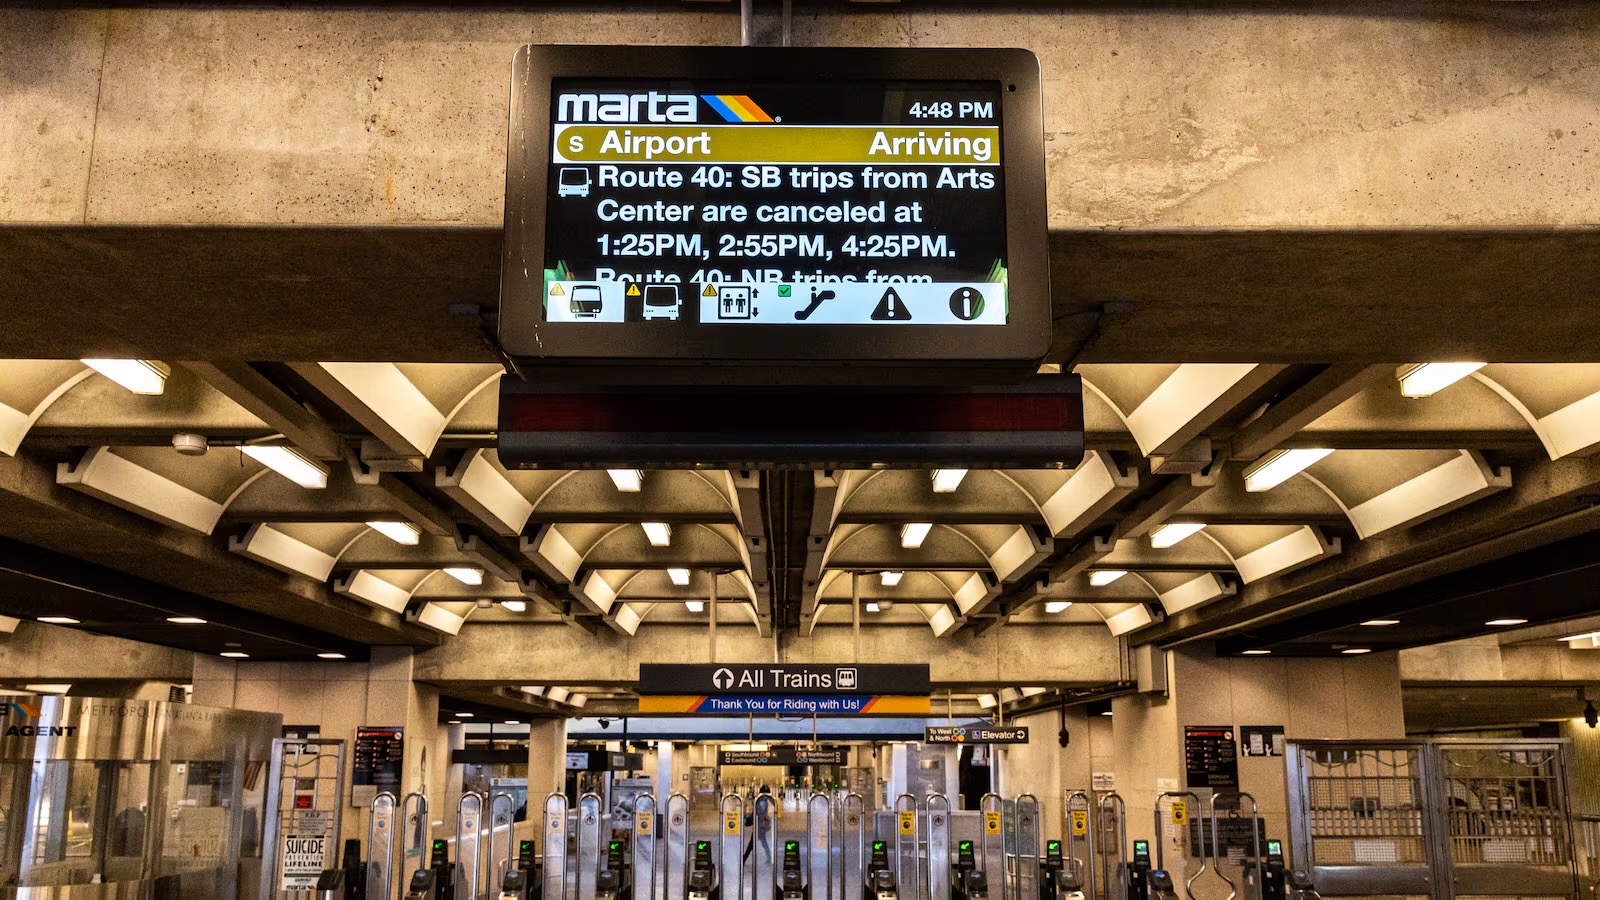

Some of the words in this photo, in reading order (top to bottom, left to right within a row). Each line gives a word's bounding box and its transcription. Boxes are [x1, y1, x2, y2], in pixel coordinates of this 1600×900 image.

[558, 91, 697, 122] marta
[909, 102, 953, 118] 4:48
[959, 102, 993, 118] PM
[600, 130, 711, 160] Airport
[868, 131, 991, 161] Arriving
[598, 165, 683, 188] Route
[690, 166, 733, 188] 40:
[741, 166, 781, 188] SB
[789, 166, 854, 193] trips
[861, 166, 928, 189] from
[936, 167, 995, 189] Arts
[597, 198, 694, 222] Center
[702, 204, 747, 222] are
[756, 201, 886, 223] canceled
[894, 202, 922, 223] at
[597, 233, 710, 261] 1:25PM,
[718, 234, 833, 261] 2:55PM,
[841, 235, 956, 258] 4:25PM.
[738, 669, 764, 688] All
[770, 669, 832, 688] Trains
[711, 699, 742, 709] Thank
[745, 699, 764, 709] You
[767, 699, 781, 709] for
[784, 699, 815, 711] Riding
[818, 699, 840, 709] with
[843, 699, 860, 709] Us!
[5, 725, 77, 737] AGENT
[981, 730, 1015, 739] Elevator
[286, 839, 324, 854] SUICIDE
